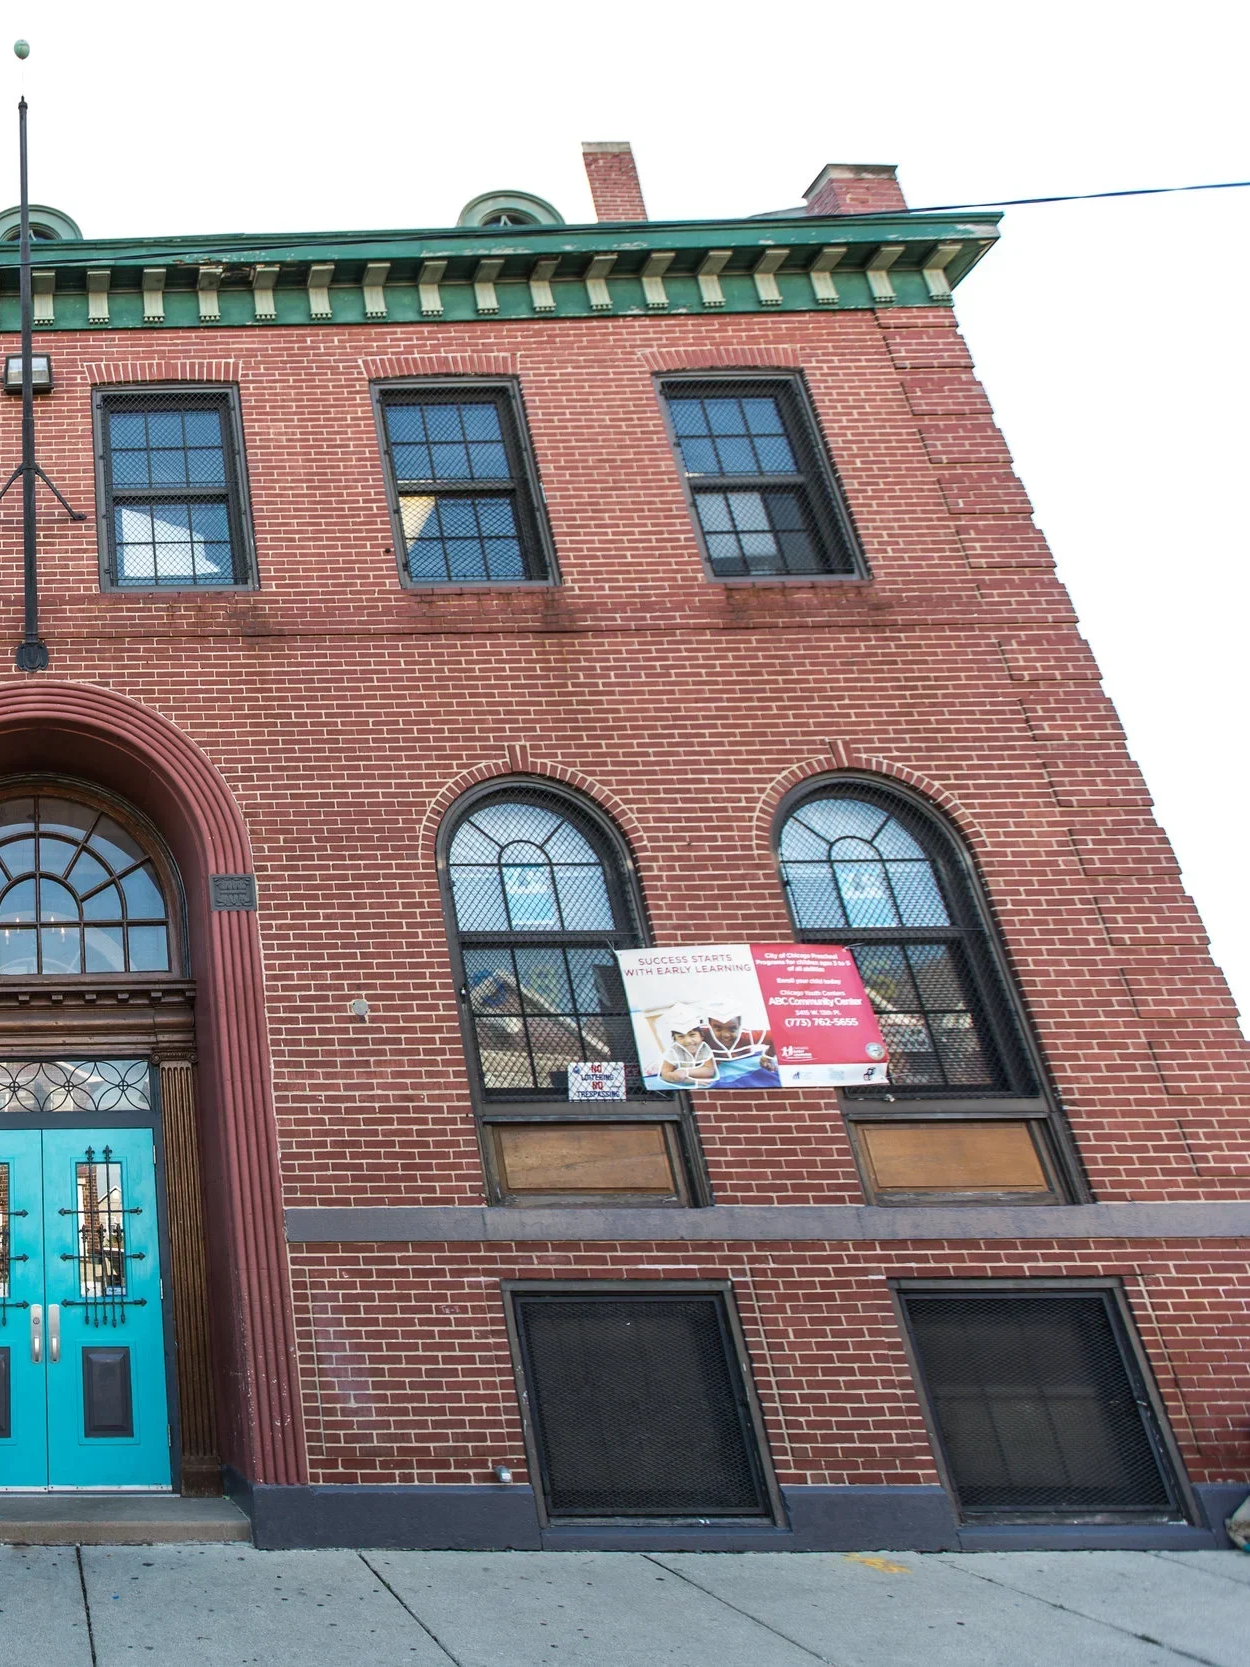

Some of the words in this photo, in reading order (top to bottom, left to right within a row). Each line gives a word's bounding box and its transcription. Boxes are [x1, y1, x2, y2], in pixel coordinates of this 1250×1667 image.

[639, 956, 688, 965] SUCCESS
[692, 954, 732, 963] STARTS
[657, 967, 690, 975] EARLY
[696, 964, 751, 973] LEARNING
[769, 997, 789, 1005] ABC
[790, 997, 834, 1006] Community
[785, 1018, 811, 1027] (773)
[813, 1018, 858, 1026] 762-5655
[591, 1065, 602, 1073] NO
